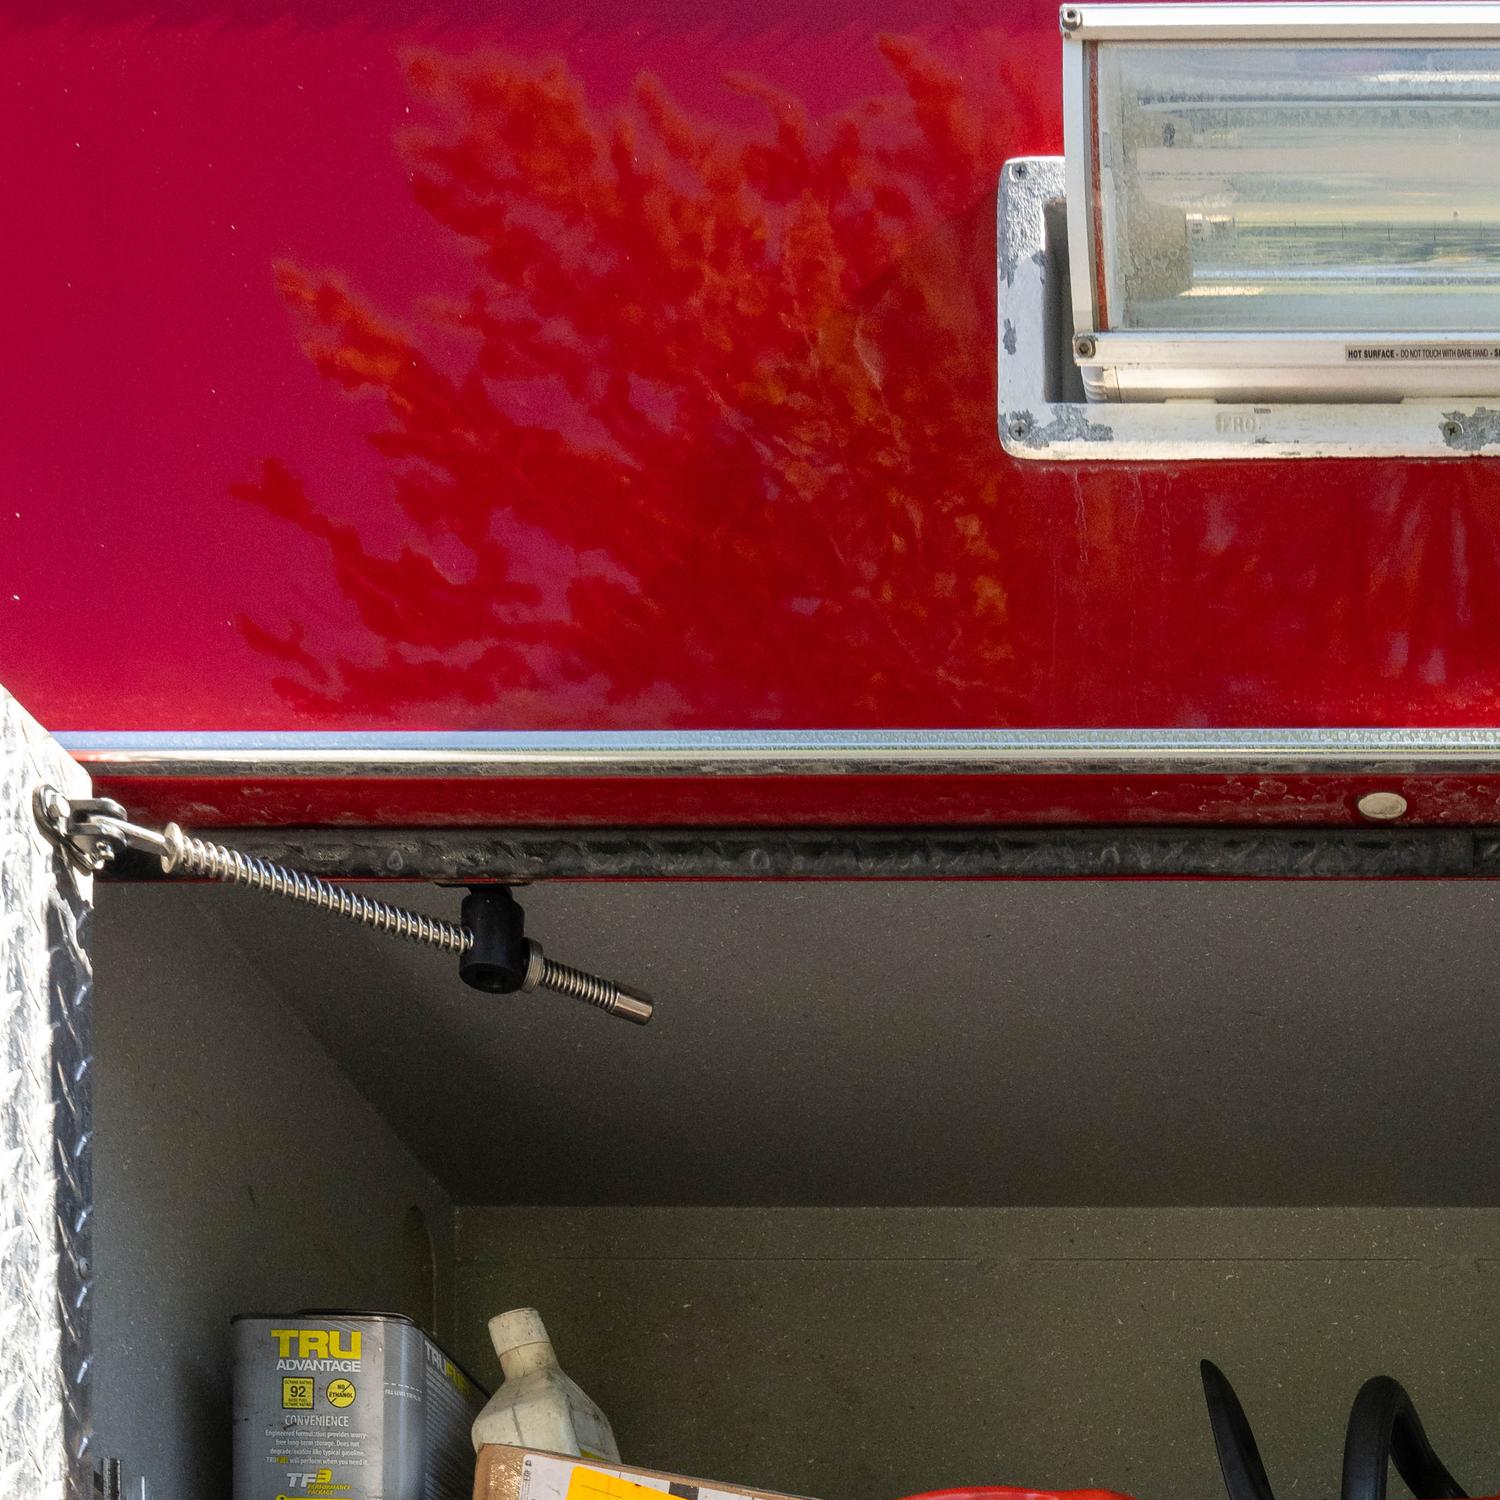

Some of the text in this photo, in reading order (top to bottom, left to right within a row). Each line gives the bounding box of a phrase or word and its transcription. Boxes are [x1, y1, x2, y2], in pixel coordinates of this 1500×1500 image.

[1348, 350, 1362, 358] HOT
[1364, 350, 1394, 358] SURFACE
[1400, 350, 1409, 358] DO
[1410, 350, 1421, 358] NOT
[1422, 350, 1441, 358] TOUCH
[1441, 349, 1456, 357] WITH
[1457, 349, 1472, 357] BARE
[1472, 349, 1488, 357] HAND
[271, 1330, 360, 1359] TRU
[276, 1360, 360, 1372] ADVANTAGE
[290, 1386, 306, 1397] 92
[285, 1415, 349, 1427] CONVENIENCE
